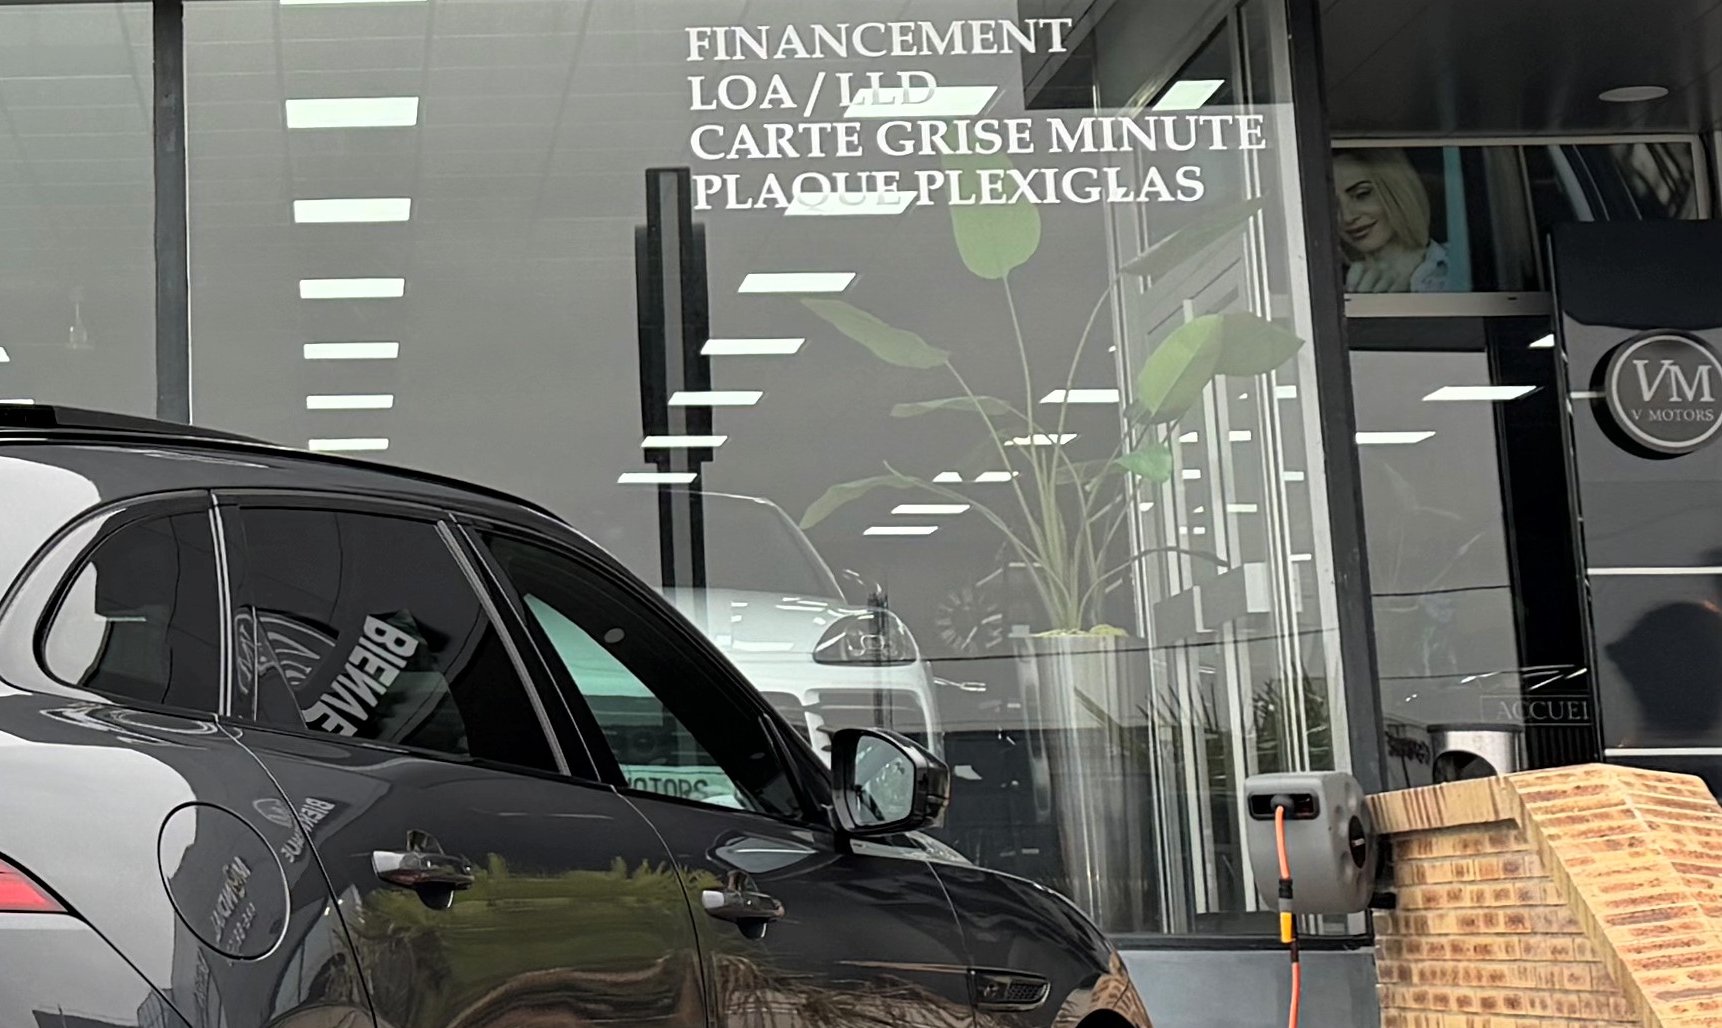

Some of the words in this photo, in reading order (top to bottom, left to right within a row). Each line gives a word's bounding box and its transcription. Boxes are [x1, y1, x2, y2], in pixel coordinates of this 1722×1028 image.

[684, 17, 1073, 61] FINANCEMENT
[689, 121, 863, 160] CARTE
[876, 119, 1035, 156] GRISE
[1046, 114, 1266, 153] MINUTE
[691, 171, 903, 211] PLAQUE
[914, 165, 1206, 206] PLEXIGLAS
[1631, 359, 1716, 402] VM
[1630, 408, 1643, 421] V
[1648, 408, 1715, 422] MOTORS
[627, 776, 709, 799] OTORS
